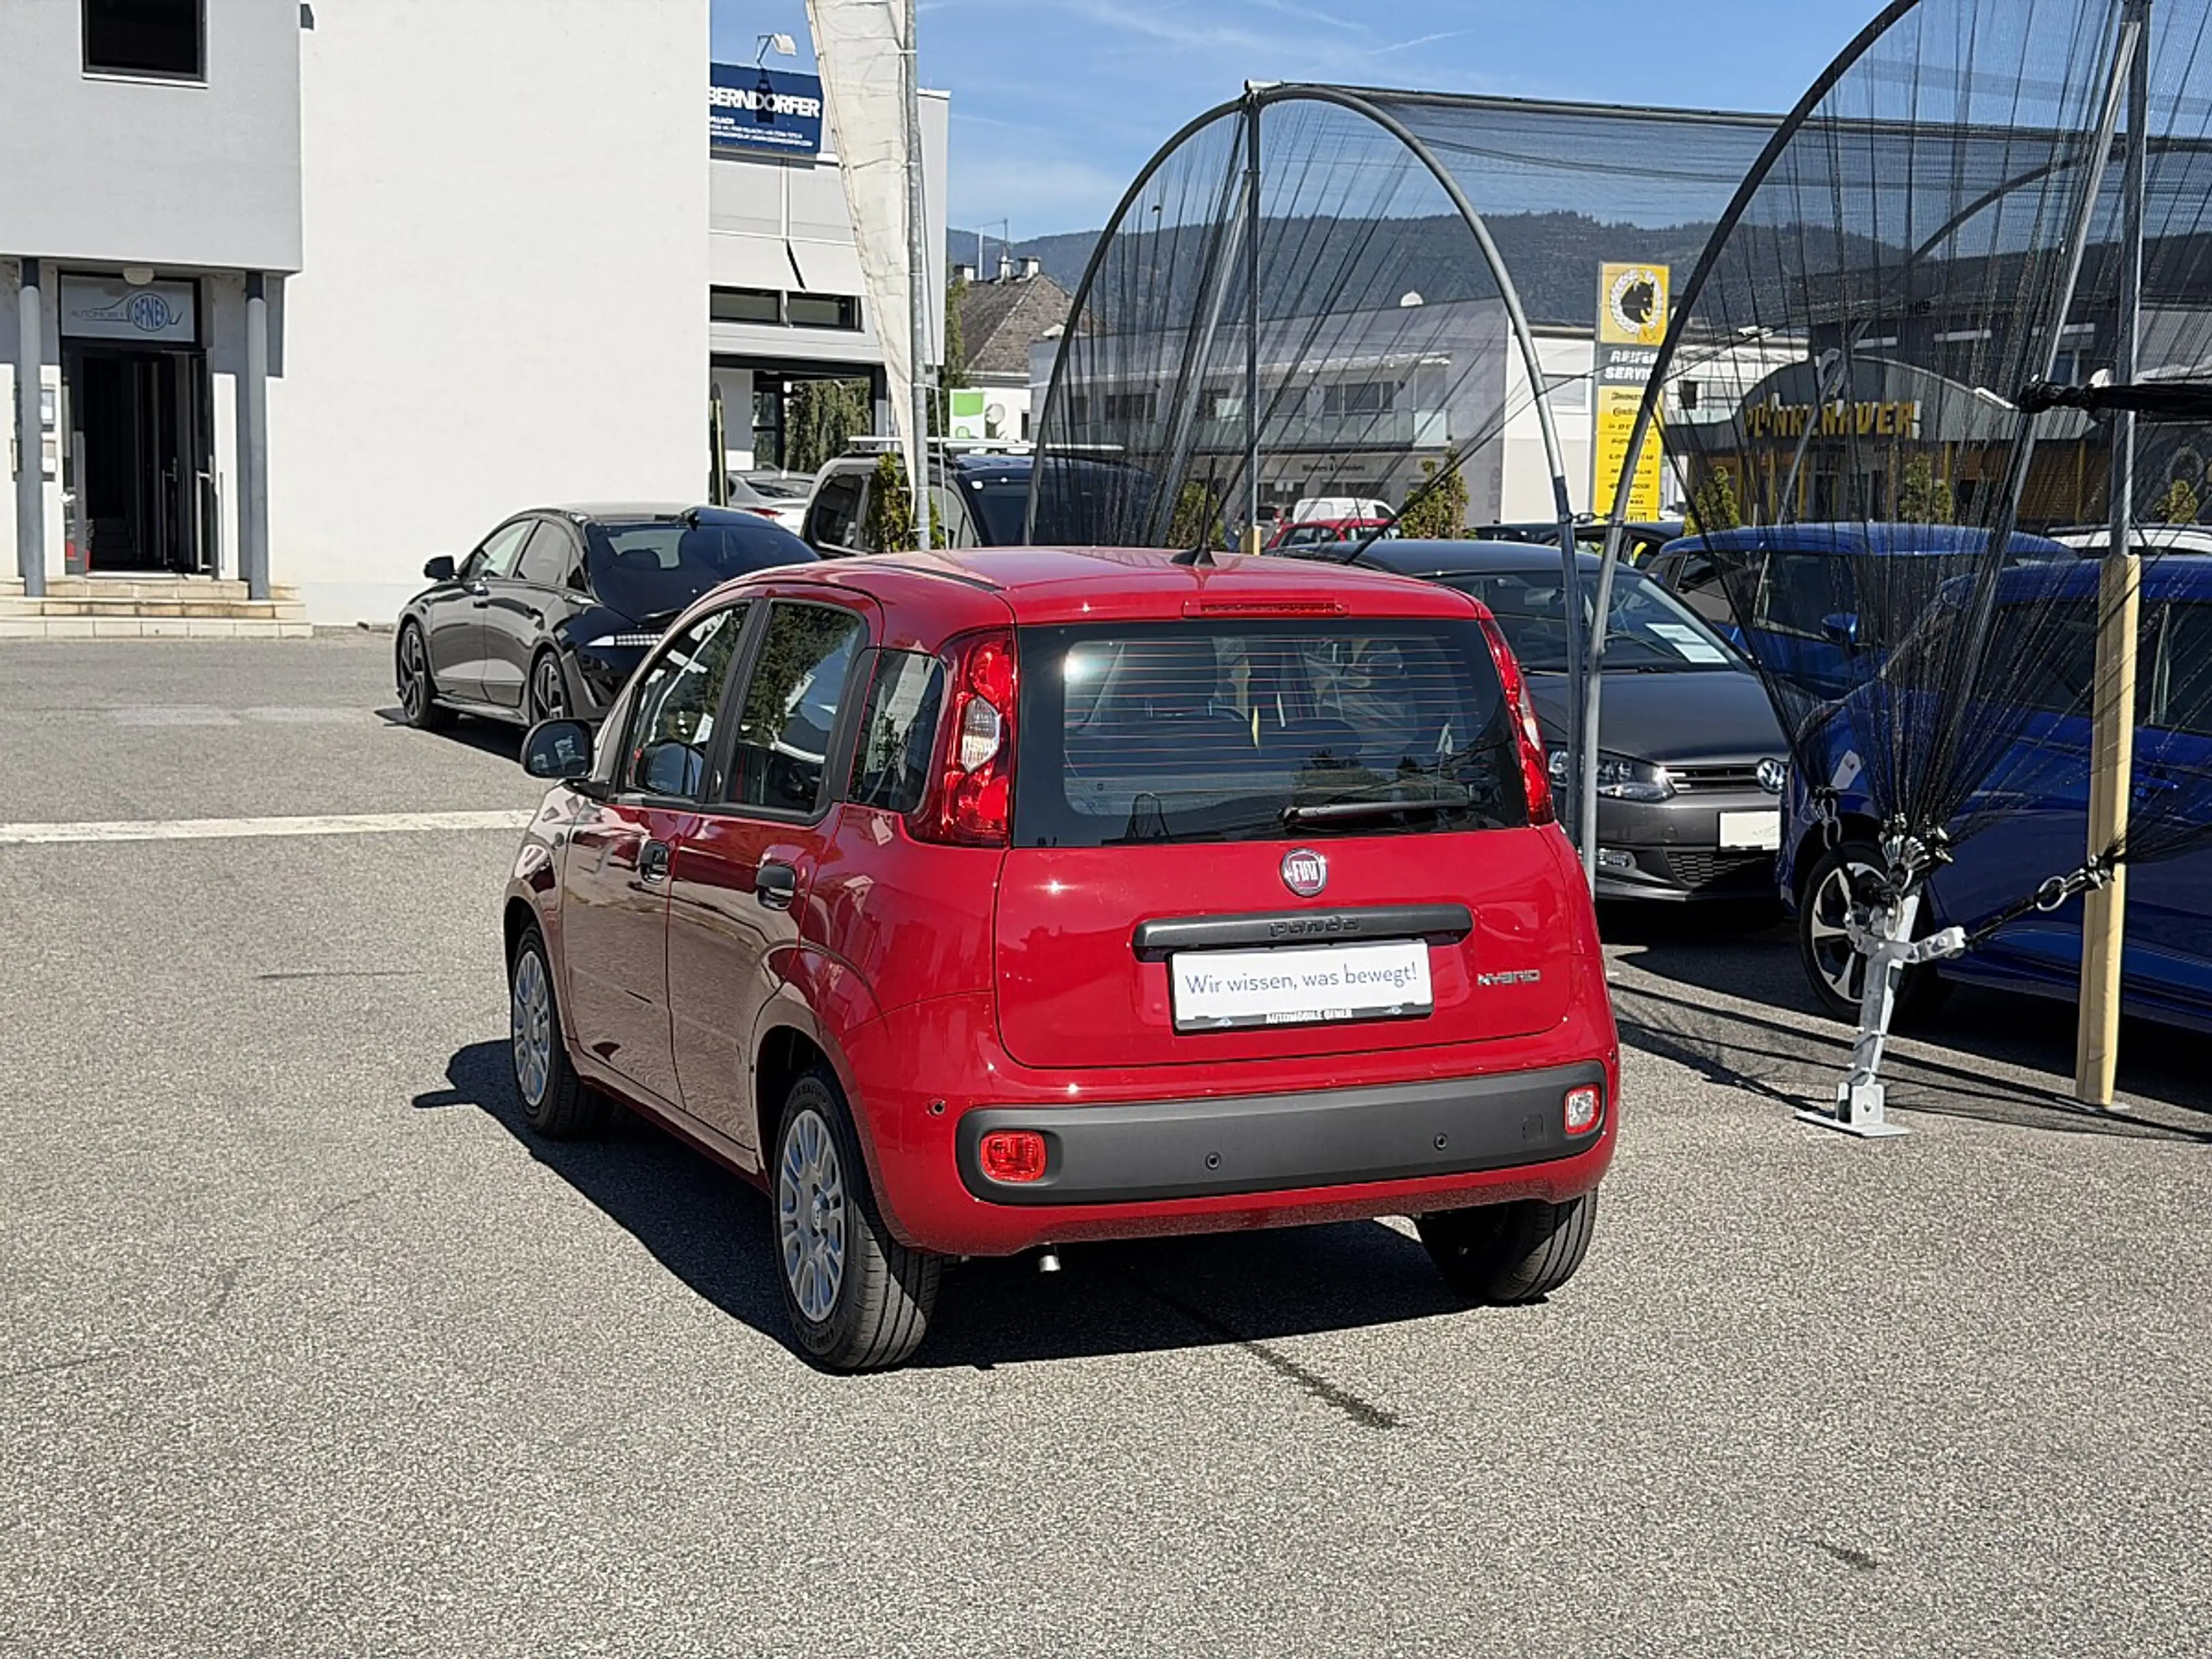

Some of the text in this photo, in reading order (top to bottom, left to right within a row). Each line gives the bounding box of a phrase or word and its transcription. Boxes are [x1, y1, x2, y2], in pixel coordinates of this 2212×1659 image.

[1185, 961, 1417, 995] Wir wissen, was bewegt!
